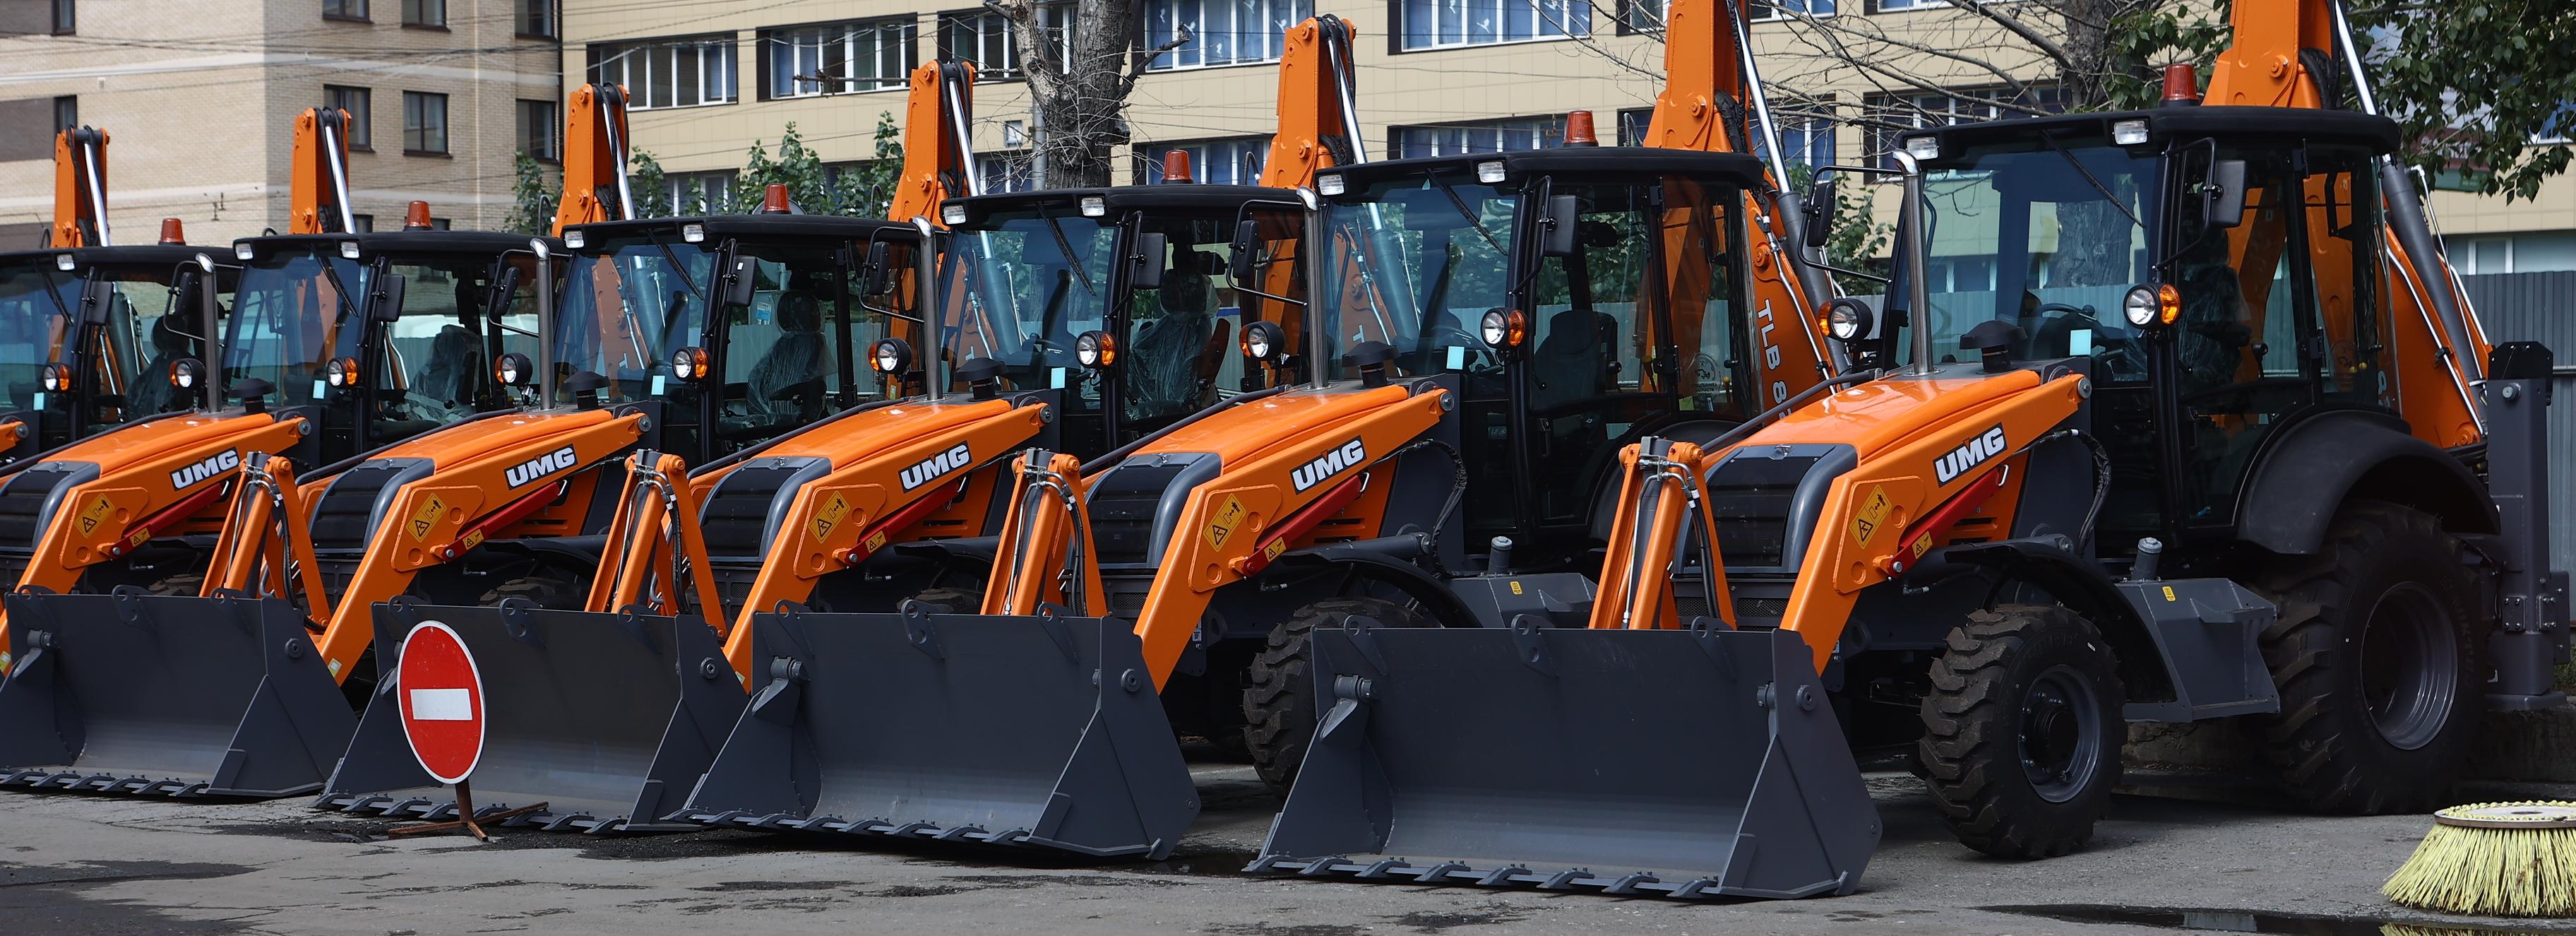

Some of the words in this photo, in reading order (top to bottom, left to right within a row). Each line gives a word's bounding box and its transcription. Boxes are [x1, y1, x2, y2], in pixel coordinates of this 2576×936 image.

[1758, 298, 1781, 370] TLB
[172, 450, 239, 488] UMG
[506, 447, 576, 487] UMG
[900, 444, 970, 490] UMG
[1292, 440, 1364, 491] UMG
[1935, 427, 2005, 482] UMG
